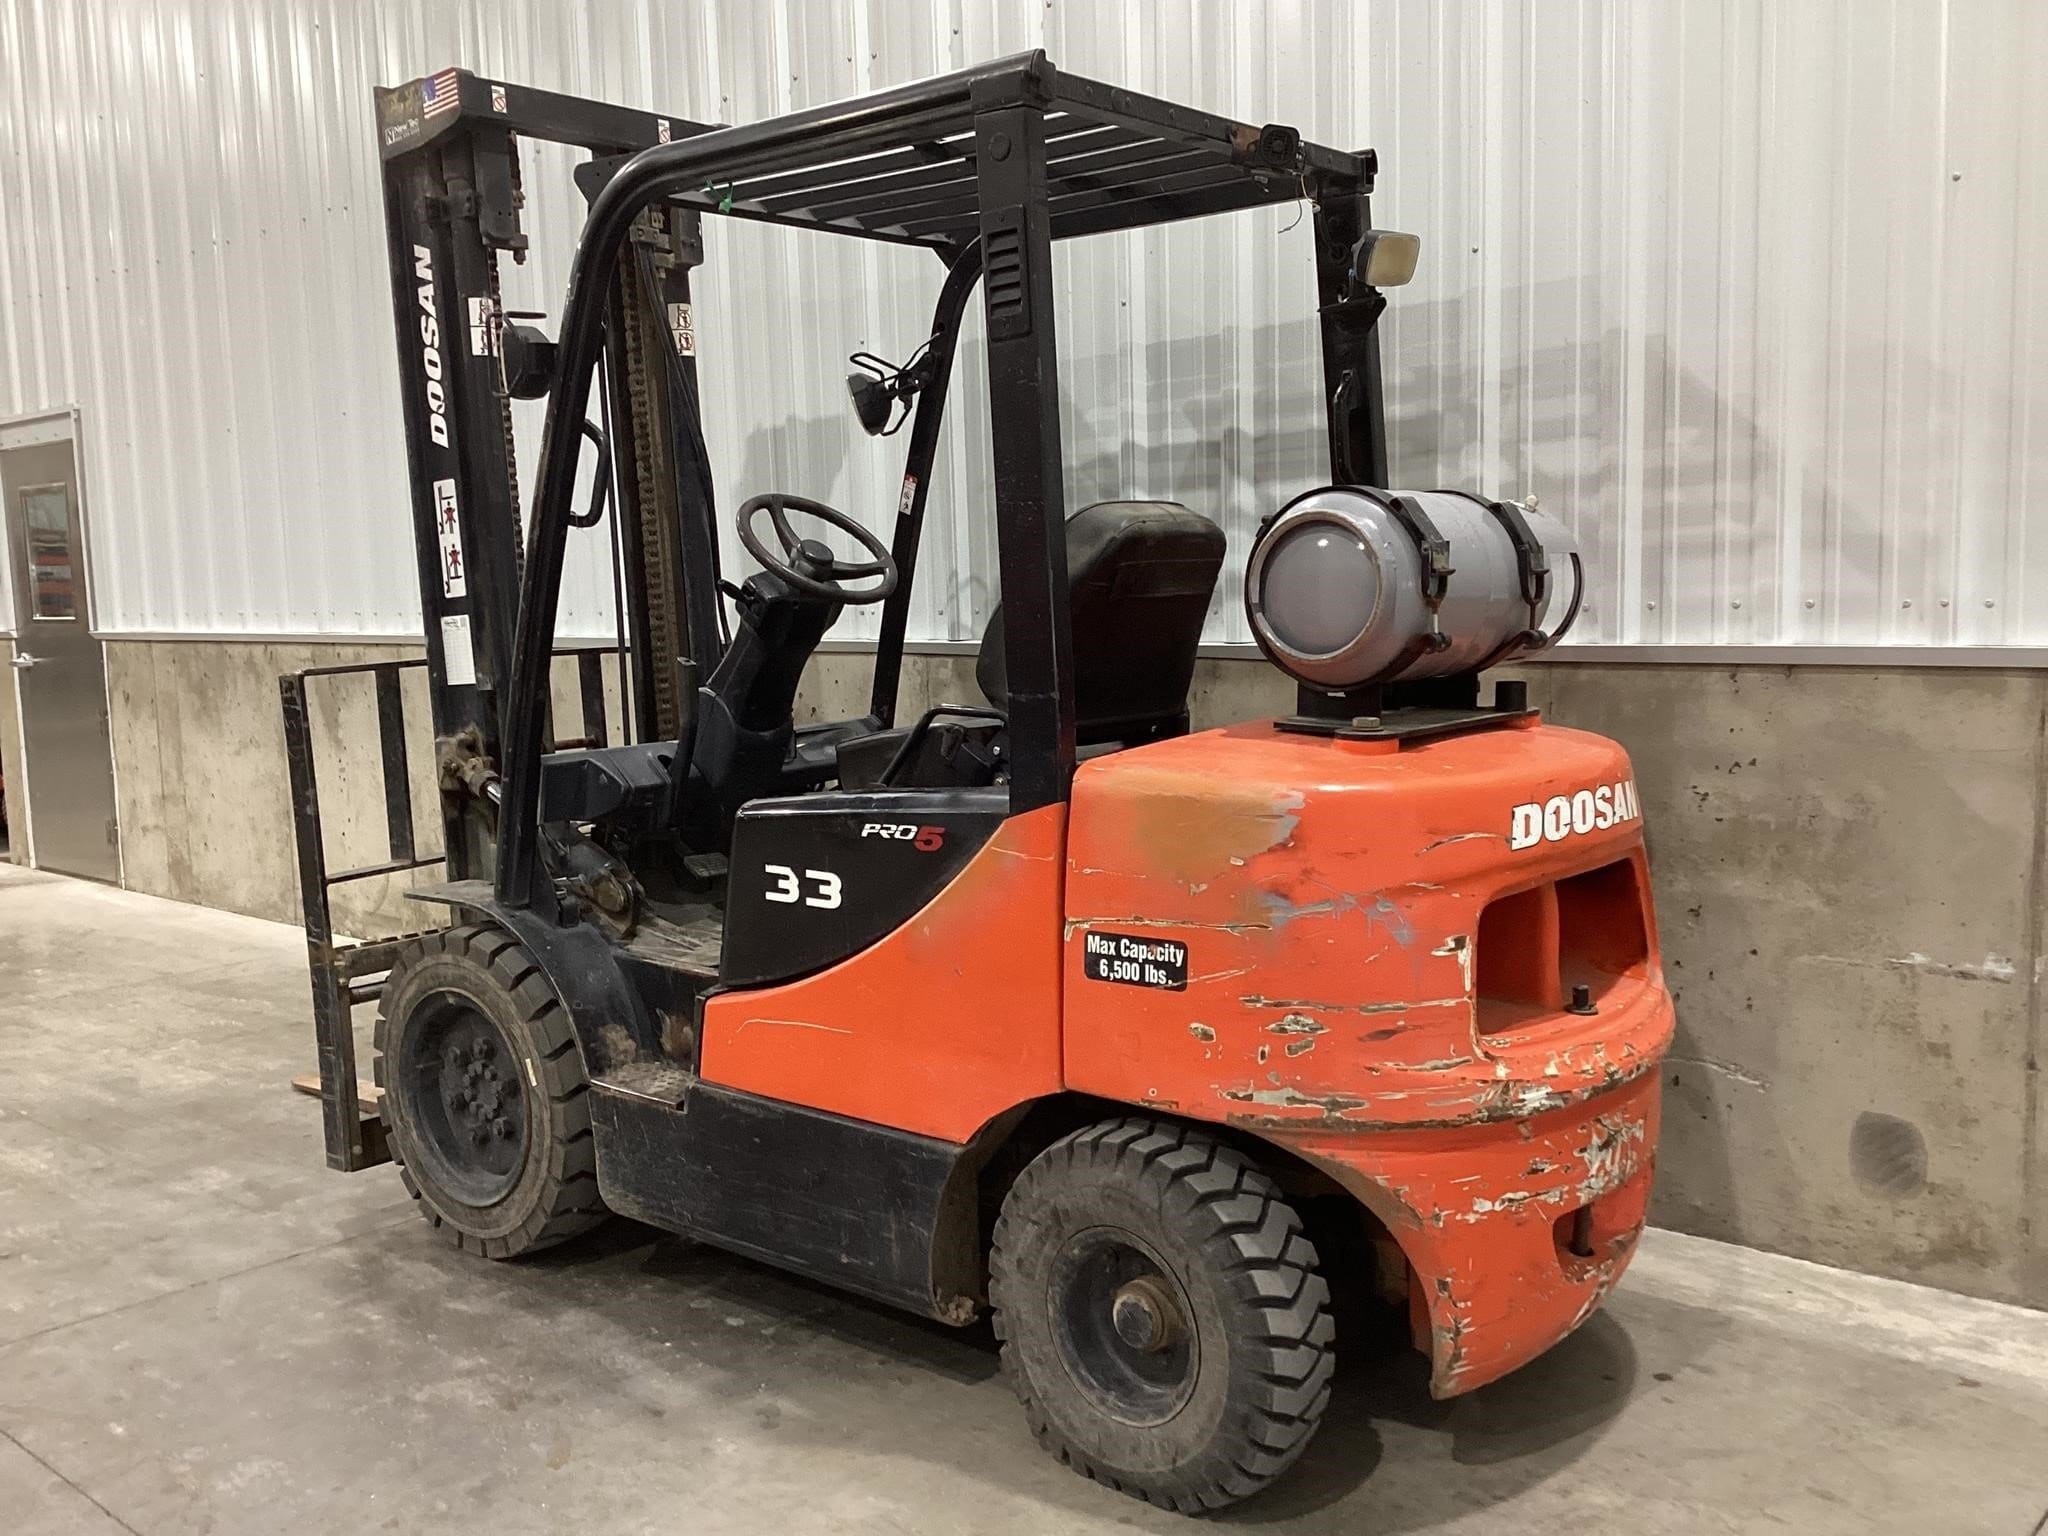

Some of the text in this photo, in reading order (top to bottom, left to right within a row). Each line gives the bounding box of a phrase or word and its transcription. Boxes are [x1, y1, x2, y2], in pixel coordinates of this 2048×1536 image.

[413, 244, 449, 449] DOOSAN
[1511, 780, 1638, 850] DOOSAN
[861, 823, 945, 851] PRO5
[765, 864, 842, 910] 33
[1087, 935, 1184, 967] Max Capacity
[1100, 959, 1173, 985] 6,500 lbs.
